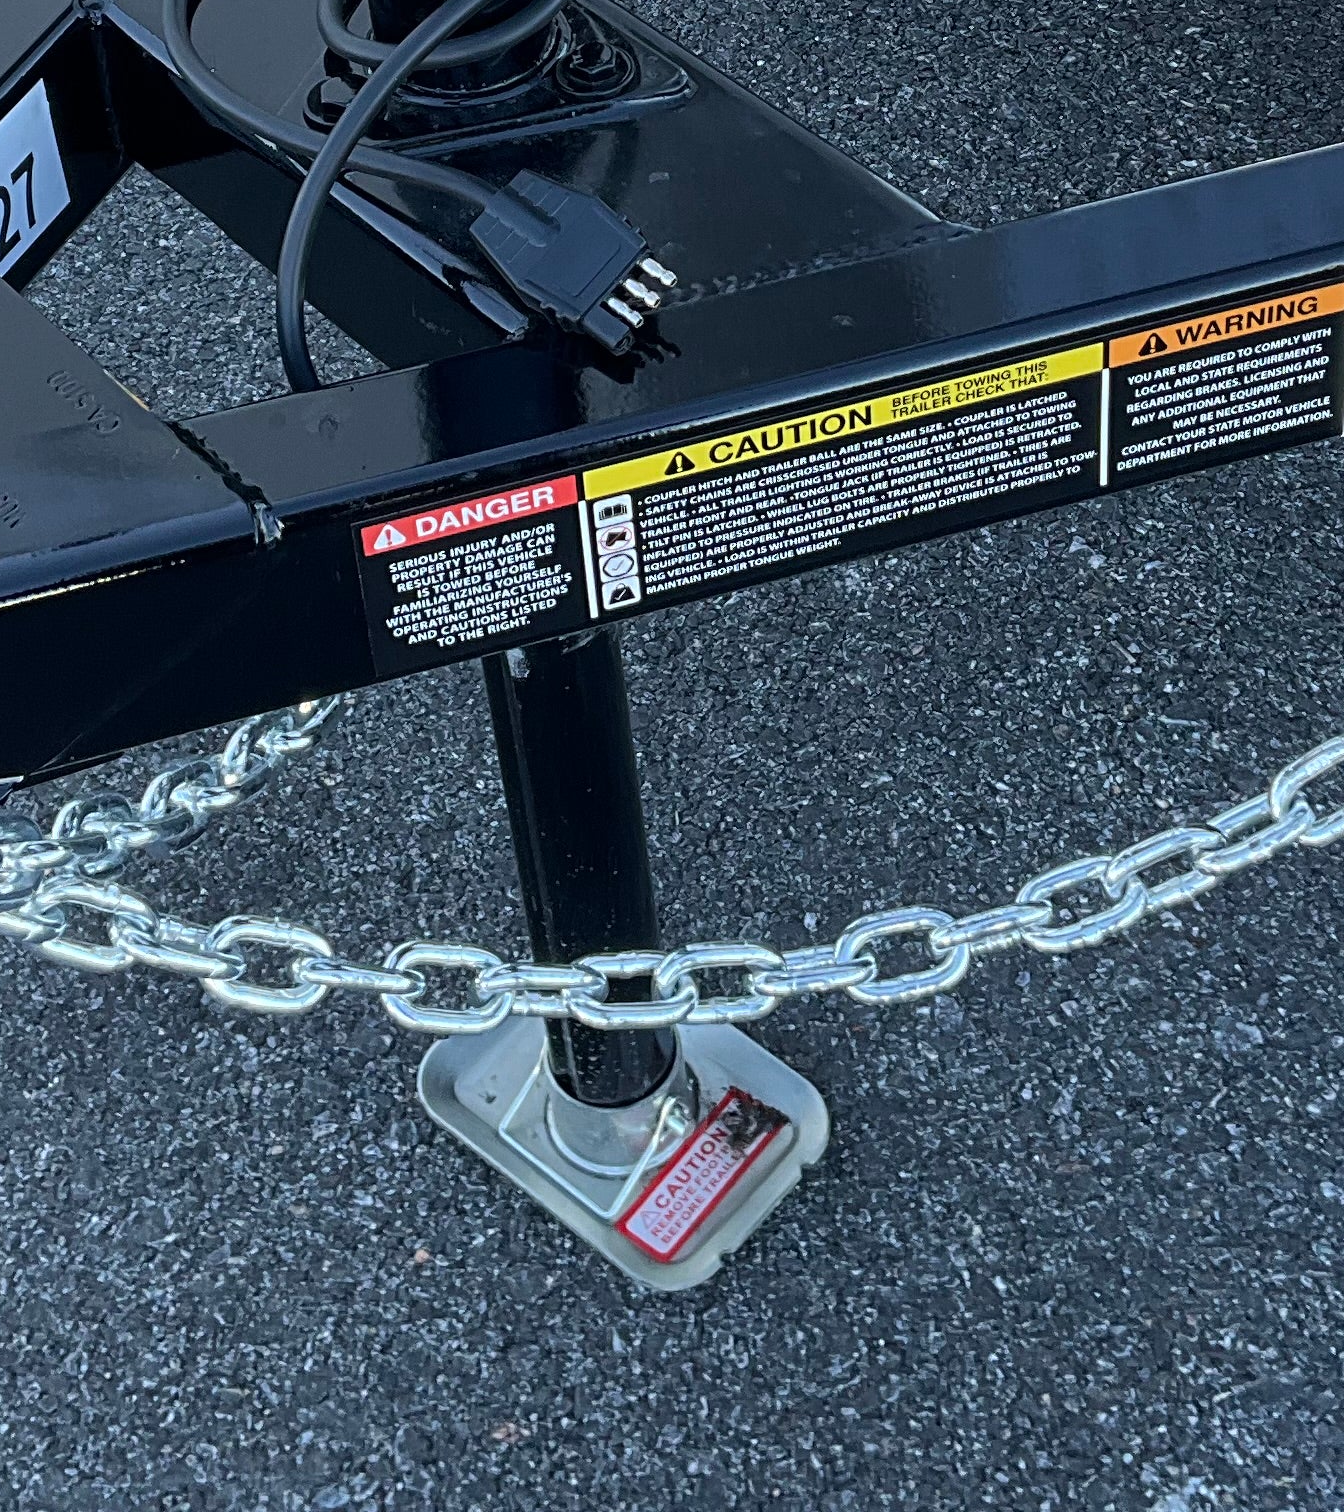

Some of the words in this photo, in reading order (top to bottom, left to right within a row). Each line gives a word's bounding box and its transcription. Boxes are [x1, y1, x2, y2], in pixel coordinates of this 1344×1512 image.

[1176, 296, 1318, 345] WARNING
[1128, 372, 1151, 385] YOU
[1154, 366, 1176, 380] ARE
[1178, 352, 1235, 373] REQUIRED
[1237, 347, 1252, 357] TO
[1255, 335, 1300, 353] COMPLY
[1302, 328, 1331, 342] WITH
[1135, 382, 1171, 397] LOCAL
[1174, 375, 1199, 388] AND
[1202, 365, 1235, 381] STATE
[1237, 344, 1322, 372] REQUIREMENTS
[891, 398, 951, 419] TRAILER
[956, 383, 1005, 402] CHECK
[892, 384, 950, 407] BEFORE
[955, 371, 1011, 391] TOWING
[1015, 361, 1048, 377] THIS
[1127, 389, 1193, 413] REGARDING
[1195, 378, 1241, 396] BRAKES.
[1244, 362, 1302, 384] LICENSING
[1304, 356, 1329, 369] AND
[1132, 412, 1155, 426] ANY
[1158, 395, 1227, 419] ADDITIONAL
[1230, 377, 1295, 401] EQUIPMENT
[1297, 370, 1325, 384] THAT
[709, 405, 872, 464] CAUTION
[1121, 436, 1173, 455] CONTACT
[1175, 427, 1206, 442] YOUR
[1208, 418, 1240, 434] STATE
[1243, 408, 1283, 425] MOTOR
[1285, 396, 1330, 414] VEHICLE
[1173, 416, 1197, 429] MAY
[1200, 412, 1213, 422] BE
[1216, 395, 1281, 418] NECESSARY.
[645, 485, 696, 504] COUPLER
[699, 476, 732, 491] HITCH
[735, 469, 760, 481] AND
[761, 457, 807, 474] TRAILER
[809, 450, 836, 463] BALL
[839, 443, 860, 455] ARE
[862, 437, 883, 449] THE
[886, 429, 916, 443] SAME
[919, 423, 945, 435] SIZE.
[954, 407, 1003, 425] COUPLER
[1006, 404, 1016, 413] IS
[1018, 392, 1067, 409] LATCHED
[1117, 444, 1192, 471] DEPARTMENT
[1194, 438, 1216, 452] FOR
[1218, 429, 1251, 445] MORE
[1253, 409, 1333, 436] INFORMATION.
[415, 486, 555, 537] DANGER
[389, 551, 446, 572] SERIOUS
[450, 537, 497, 557] INJURY
[502, 523, 554, 544] AND/OR
[392, 558, 460, 583] PROPERTY
[465, 542, 523, 564] DAMAGE
[527, 534, 555, 548] CAN
[397, 573, 445, 592] RESULT
[449, 569, 460, 580] IF
[464, 560, 494, 574] THIS
[497, 545, 552, 566] VEHICLE
[647, 574, 701, 594] MAINTAIN
[704, 562, 747, 579] PROPER
[748, 550, 794, 567] TONGUE
[796, 538, 841, 555] WEIGHT.
[386, 612, 421, 628] WITH
[424, 604, 450, 618] THE
[454, 573, 572, 610] MANUFACTURER'S
[393, 583, 492, 615] FAMILIARIZING
[495, 564, 561, 588] YOURSELF
[417, 588, 430, 598] IS
[432, 575, 481, 593] TOWED
[485, 560, 535, 581] BEFORE
[393, 611, 468, 637] OPERATING
[472, 584, 568, 616] INSTRUCTIONS
[409, 630, 437, 644] AND
[441, 611, 508, 636] CAUTIONS
[512, 599, 556, 617] LISTED
[437, 636, 455, 647] TO
[458, 628, 484, 641] THE
[488, 616, 530, 634] RIGHT.
[655, 1127, 729, 1210] CAUTION
[651, 1187, 696, 1237] REMOVE
[661, 1195, 705, 1244] BEFORE
